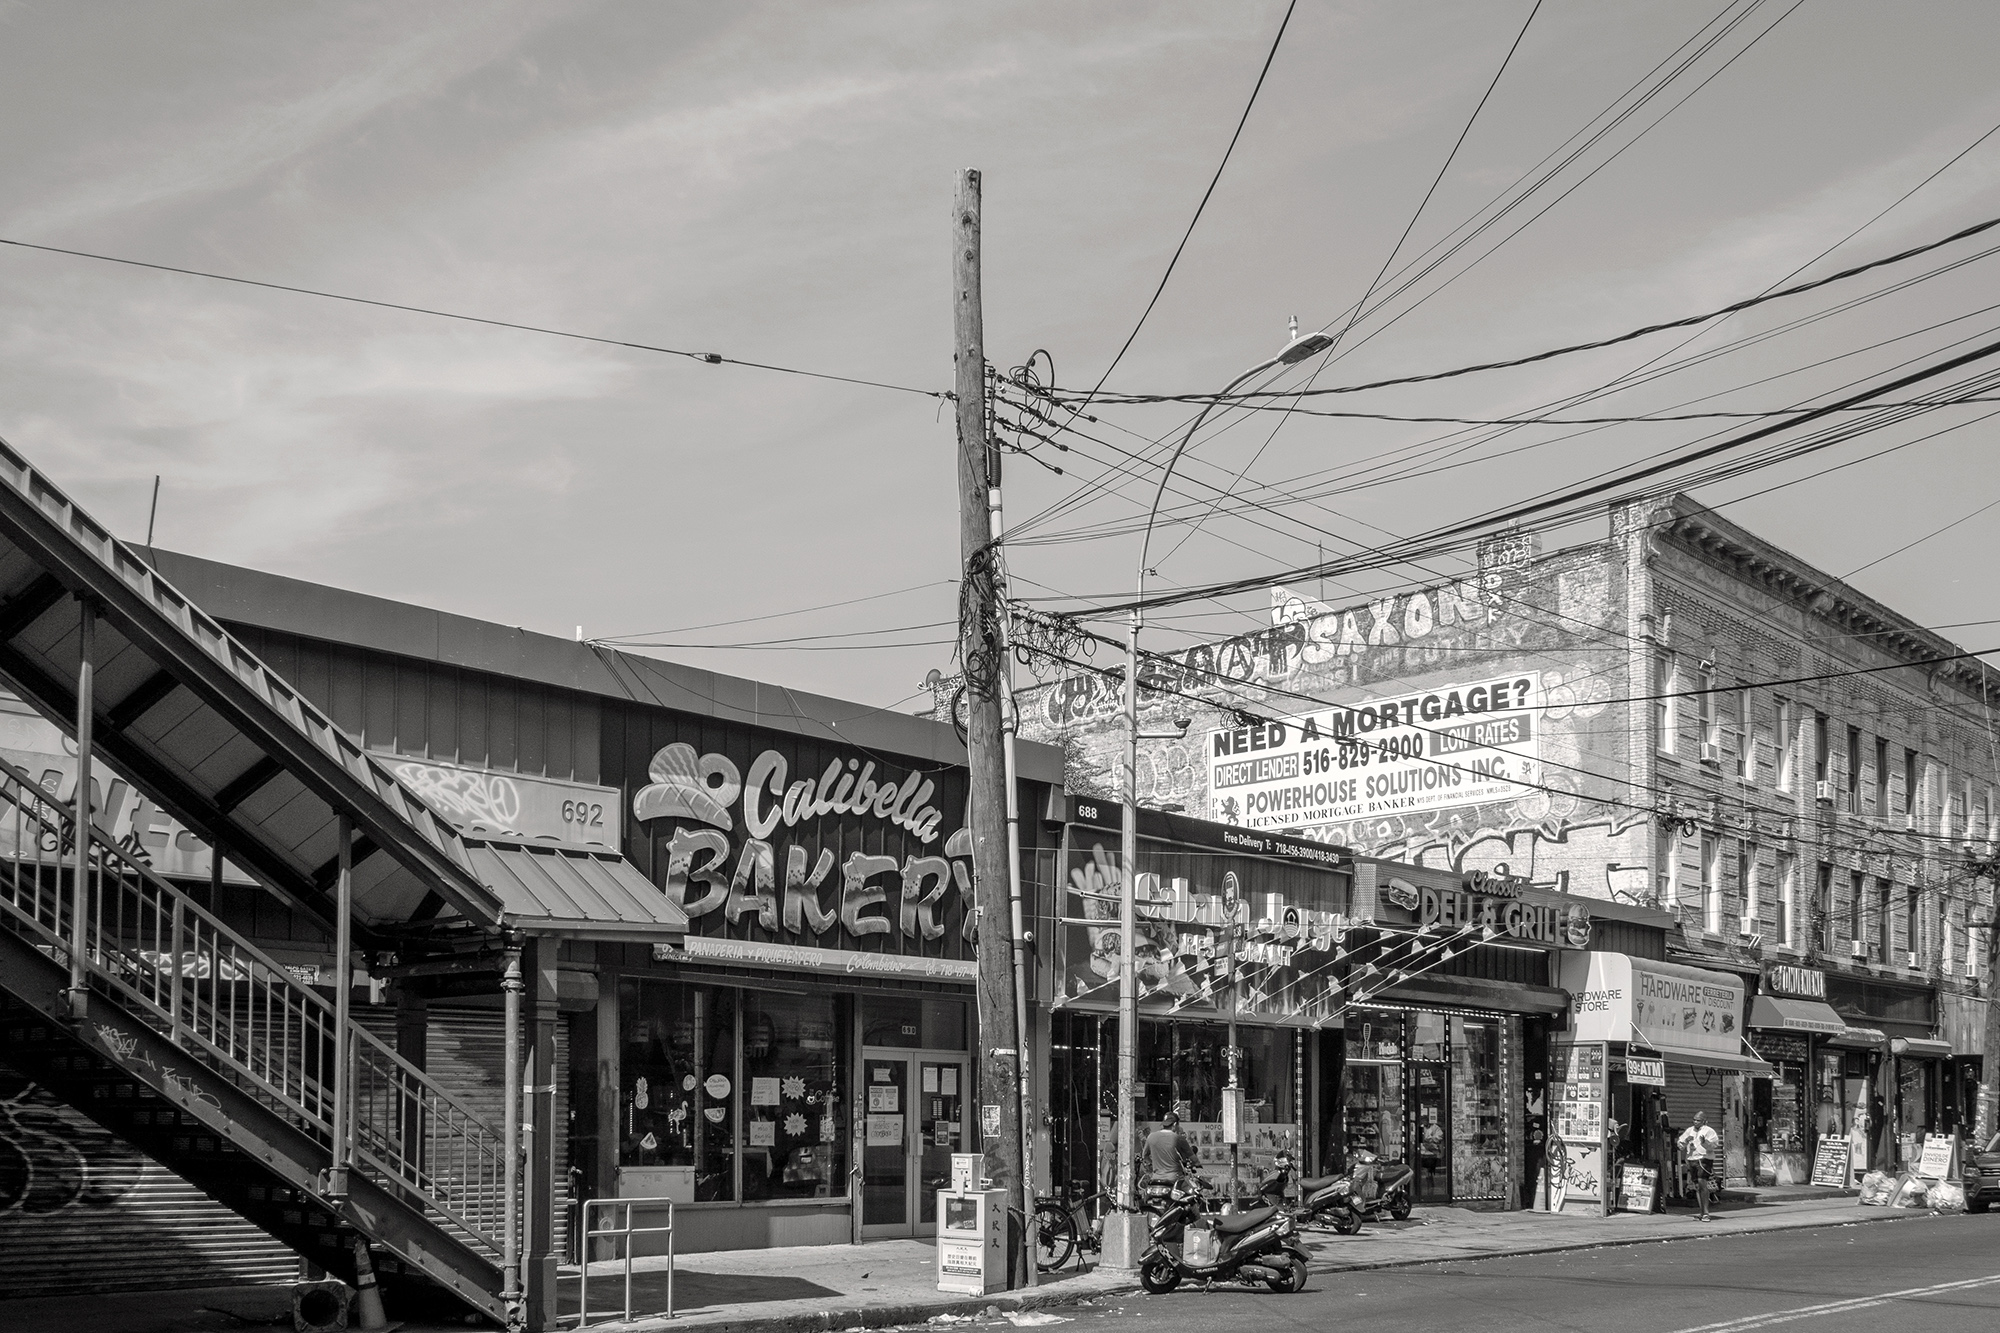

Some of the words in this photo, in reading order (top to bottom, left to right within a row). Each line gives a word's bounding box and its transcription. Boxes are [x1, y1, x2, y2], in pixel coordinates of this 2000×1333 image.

[1301, 578, 1485, 664] SAXON
[1214, 722, 1287, 758] NEED
[1300, 716, 1321, 744] A
[1332, 678, 1531, 738] MORTGAGE?
[1440, 726, 1471, 753] LOW
[1475, 718, 1520, 747] RATES
[1303, 732, 1423, 776] 516-829-2900
[1216, 763, 1253, 788] DIRECT
[1255, 755, 1298, 782] LENDER
[1246, 778, 1357, 815] POWERHOUSE
[1365, 762, 1462, 799] SOLUTIONS
[1471, 756, 1511, 784] INC.
[743, 748, 945, 844] Calibella
[1443, 791, 1464, 801] FINANCIAL
[1464, 788, 1484, 798] SERVICES
[561, 799, 604, 827] 692
[1078, 804, 1098, 820] 688
[1246, 813, 1299, 828] LICENSED
[1303, 803, 1364, 821] MORTGAGE
[1368, 796, 1415, 812] BANKER
[1224, 831, 1238, 845] Free
[1239, 833, 1263, 852] Delivery
[1265, 838, 1272, 850] T:
[1469, 868, 1524, 899] Classic
[1421, 886, 1474, 928] DELI
[1481, 898, 1497, 931] &
[1504, 901, 1567, 944] GRILL
[1570, 989, 1622, 1003] ARDWARE
[1641, 976, 1702, 1004] HARDWARE
[1704, 987, 1733, 1000] FERRETERIA
[1575, 1000, 1610, 1014] STORE
[902, 1026, 916, 1034] 690
